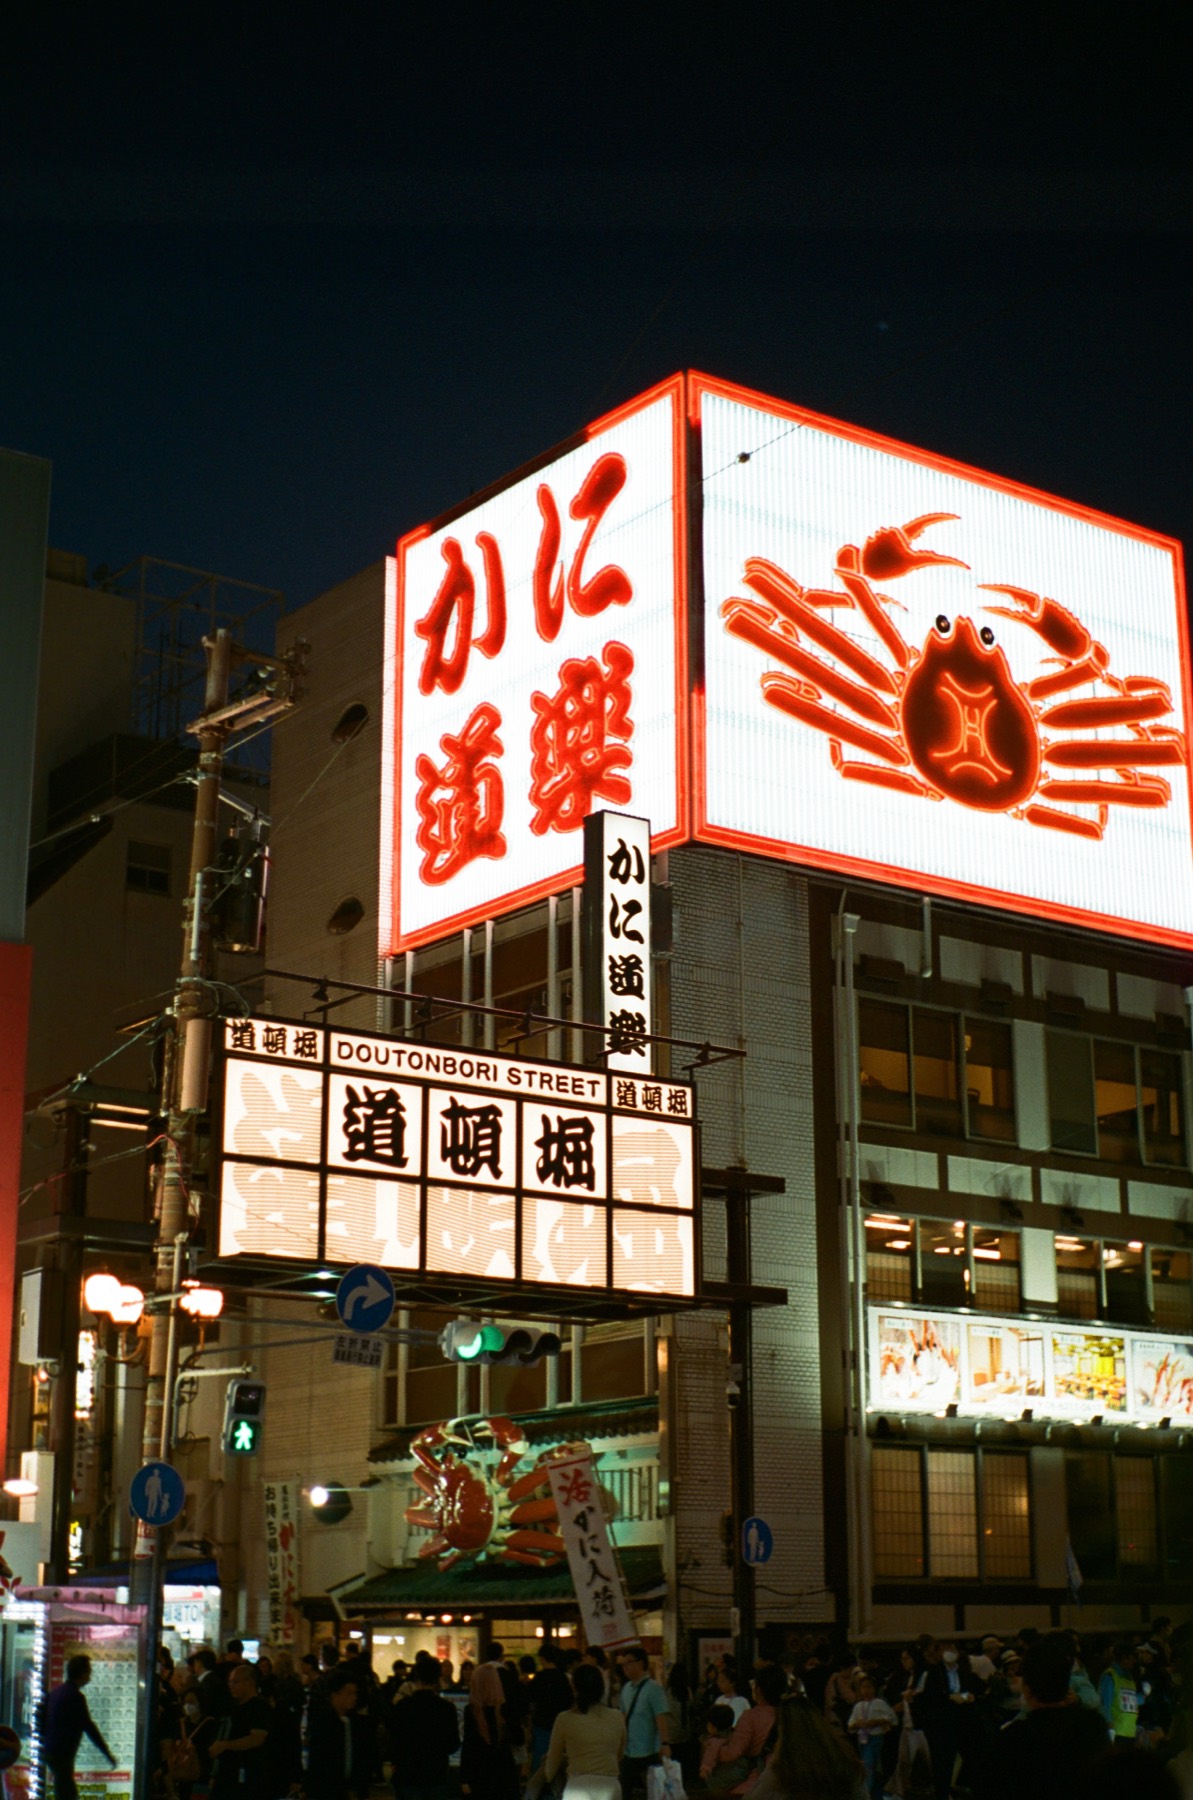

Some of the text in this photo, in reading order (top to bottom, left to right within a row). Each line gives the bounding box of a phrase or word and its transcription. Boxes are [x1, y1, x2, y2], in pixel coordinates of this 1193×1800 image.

[417, 452, 632, 694] かに
[226, 1019, 317, 1059] 道頓堀
[337, 1041, 600, 1097] DOUTONBORI STREET
[617, 1080, 688, 1116] 道頓堀
[343, 1085, 596, 1191] 道頓堀
